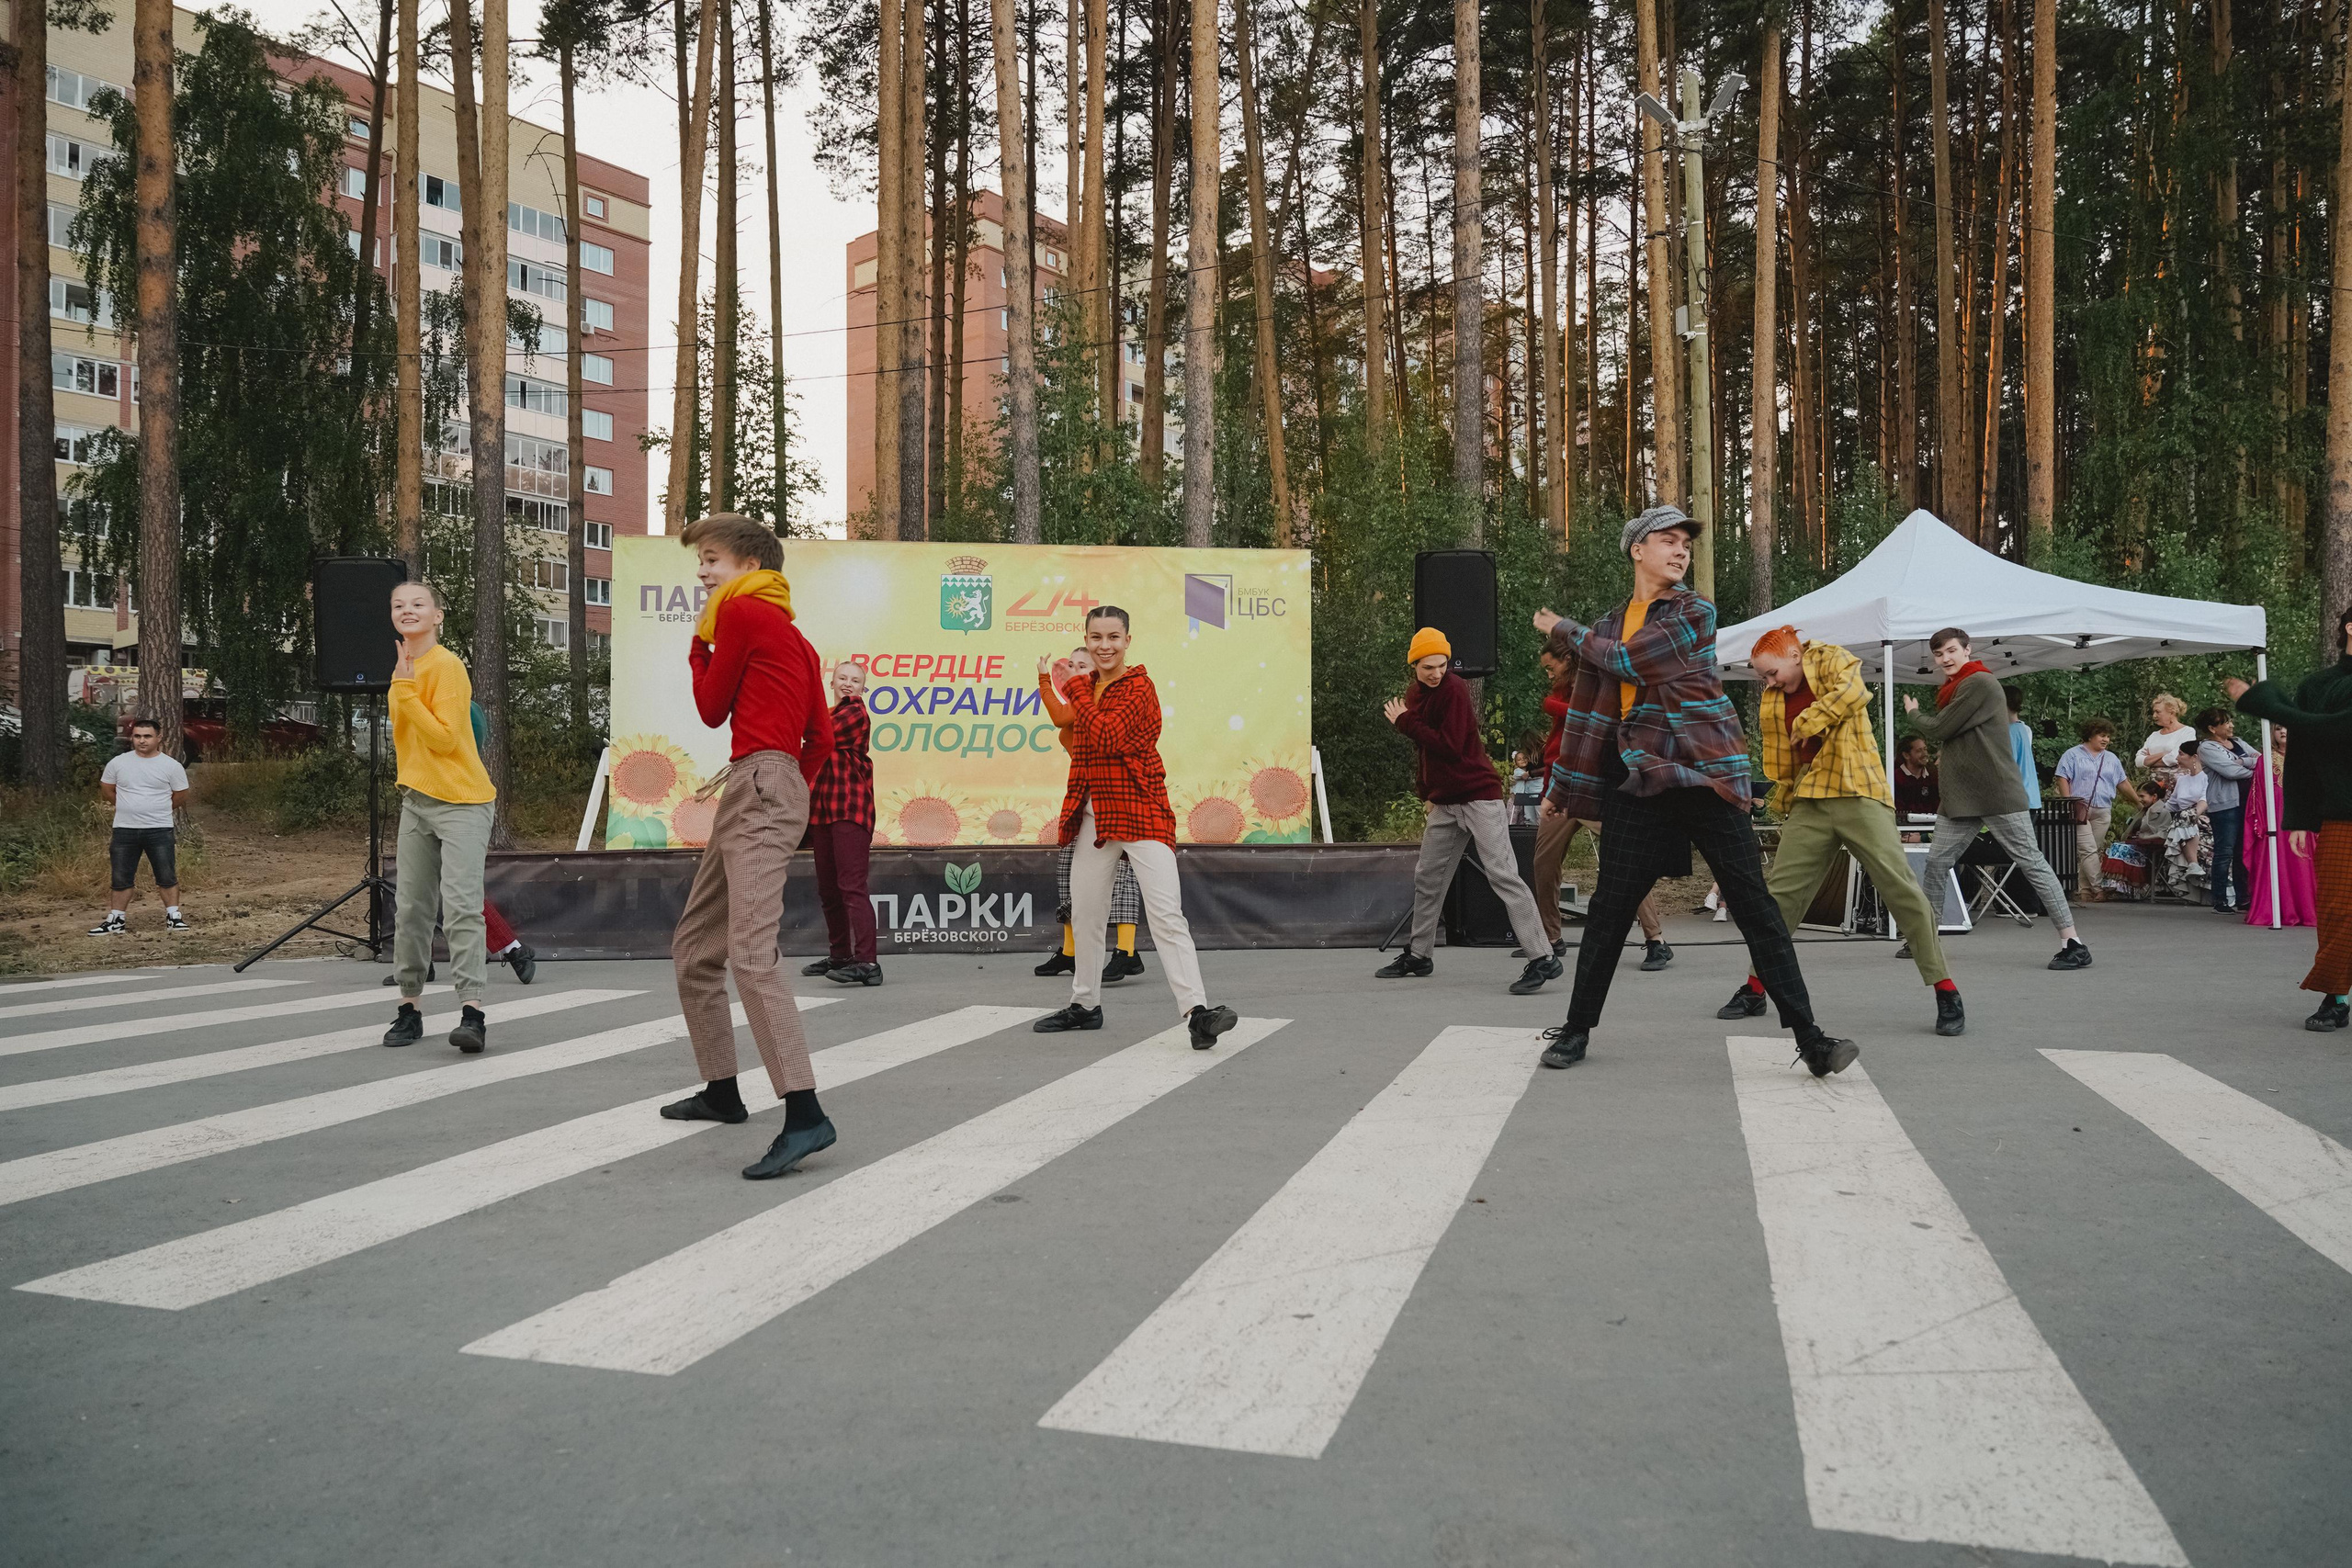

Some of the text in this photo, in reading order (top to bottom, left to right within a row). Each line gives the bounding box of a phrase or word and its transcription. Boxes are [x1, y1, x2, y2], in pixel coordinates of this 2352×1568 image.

[640, 585, 707, 612] ПАР
[1238, 588, 1270, 596] БМБУК
[1238, 597, 1286, 620] ЦБС
[1005, 621, 1085, 633] БЕРЁЗОВСК
[864, 685, 1042, 716] ОХРАНИ
[871, 722, 1067, 759] ОЛОДОС
[869, 892, 1033, 930] ПАРКИ
[894, 929, 1009, 942] БЕРЁЗОВСКОГО
